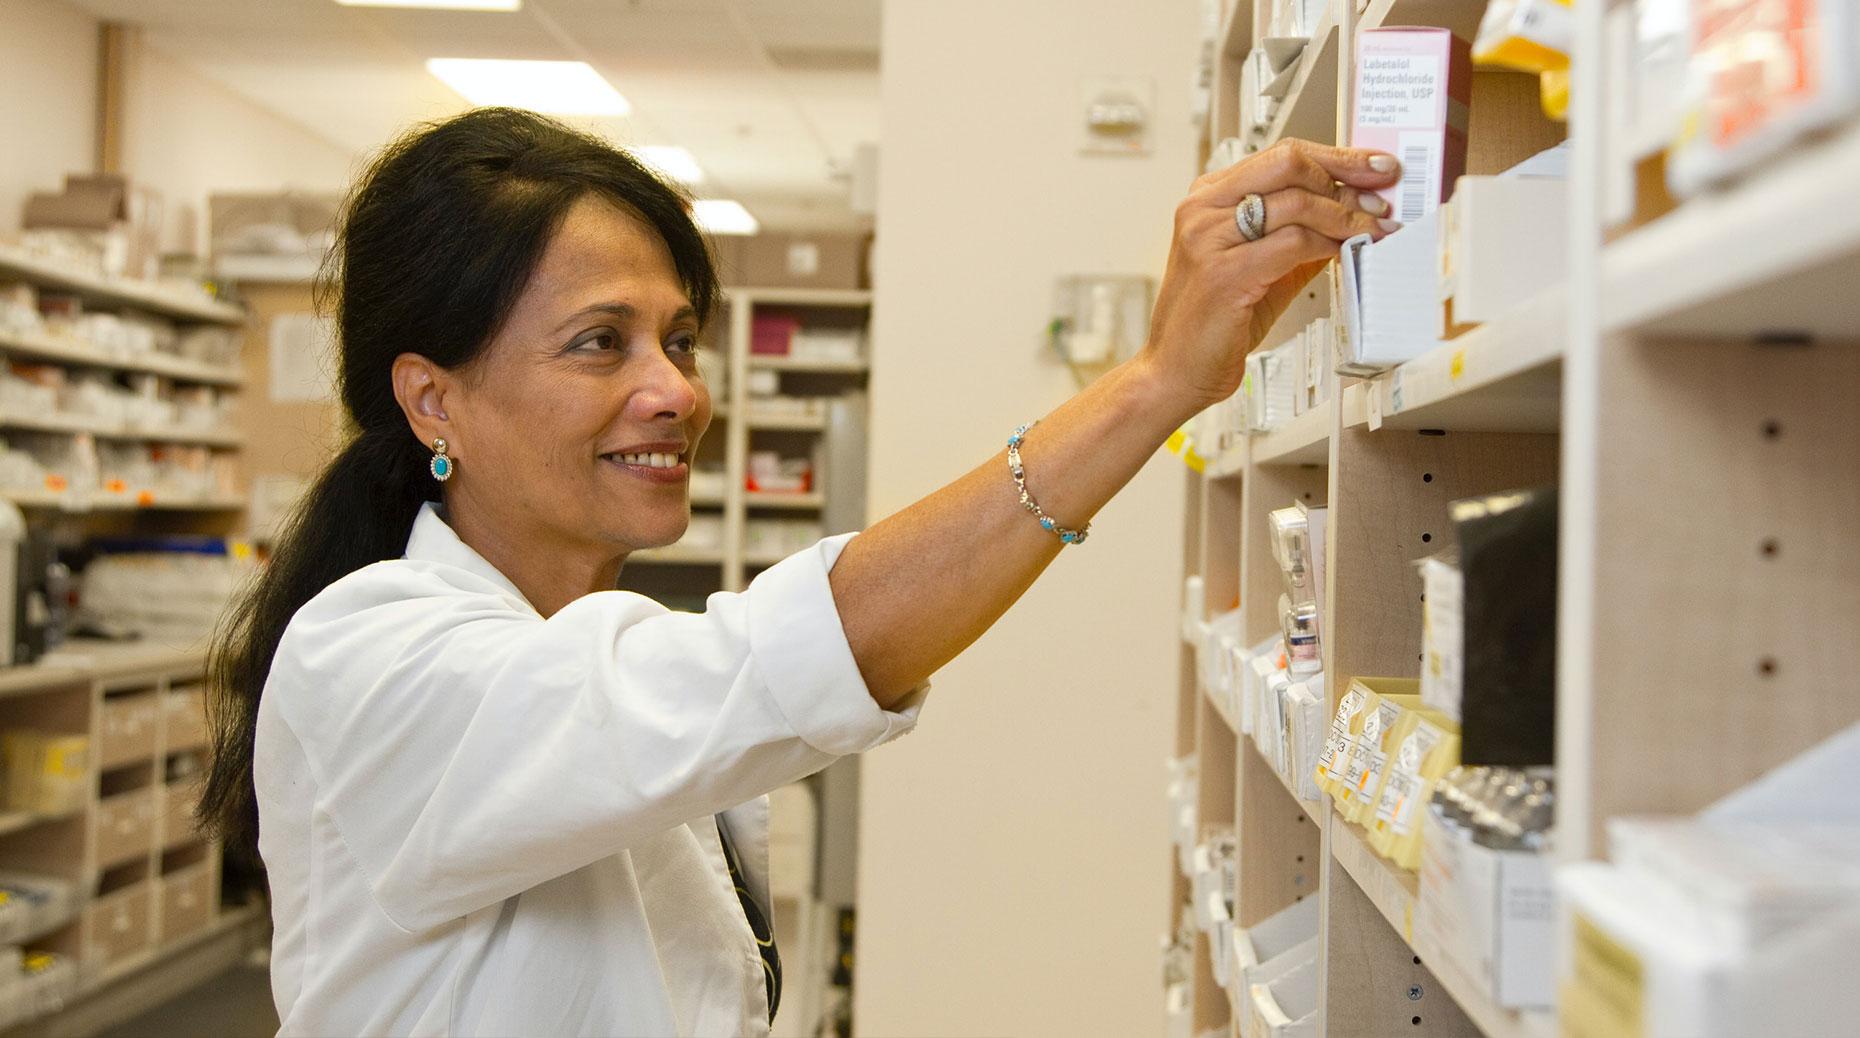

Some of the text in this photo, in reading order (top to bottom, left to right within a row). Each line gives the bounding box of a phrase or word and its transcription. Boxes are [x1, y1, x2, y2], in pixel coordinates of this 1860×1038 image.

[1363, 58, 1410, 69] Labetalol
[1362, 72, 1434, 86] Hydrochloride
[1412, 87, 1434, 99] USP
